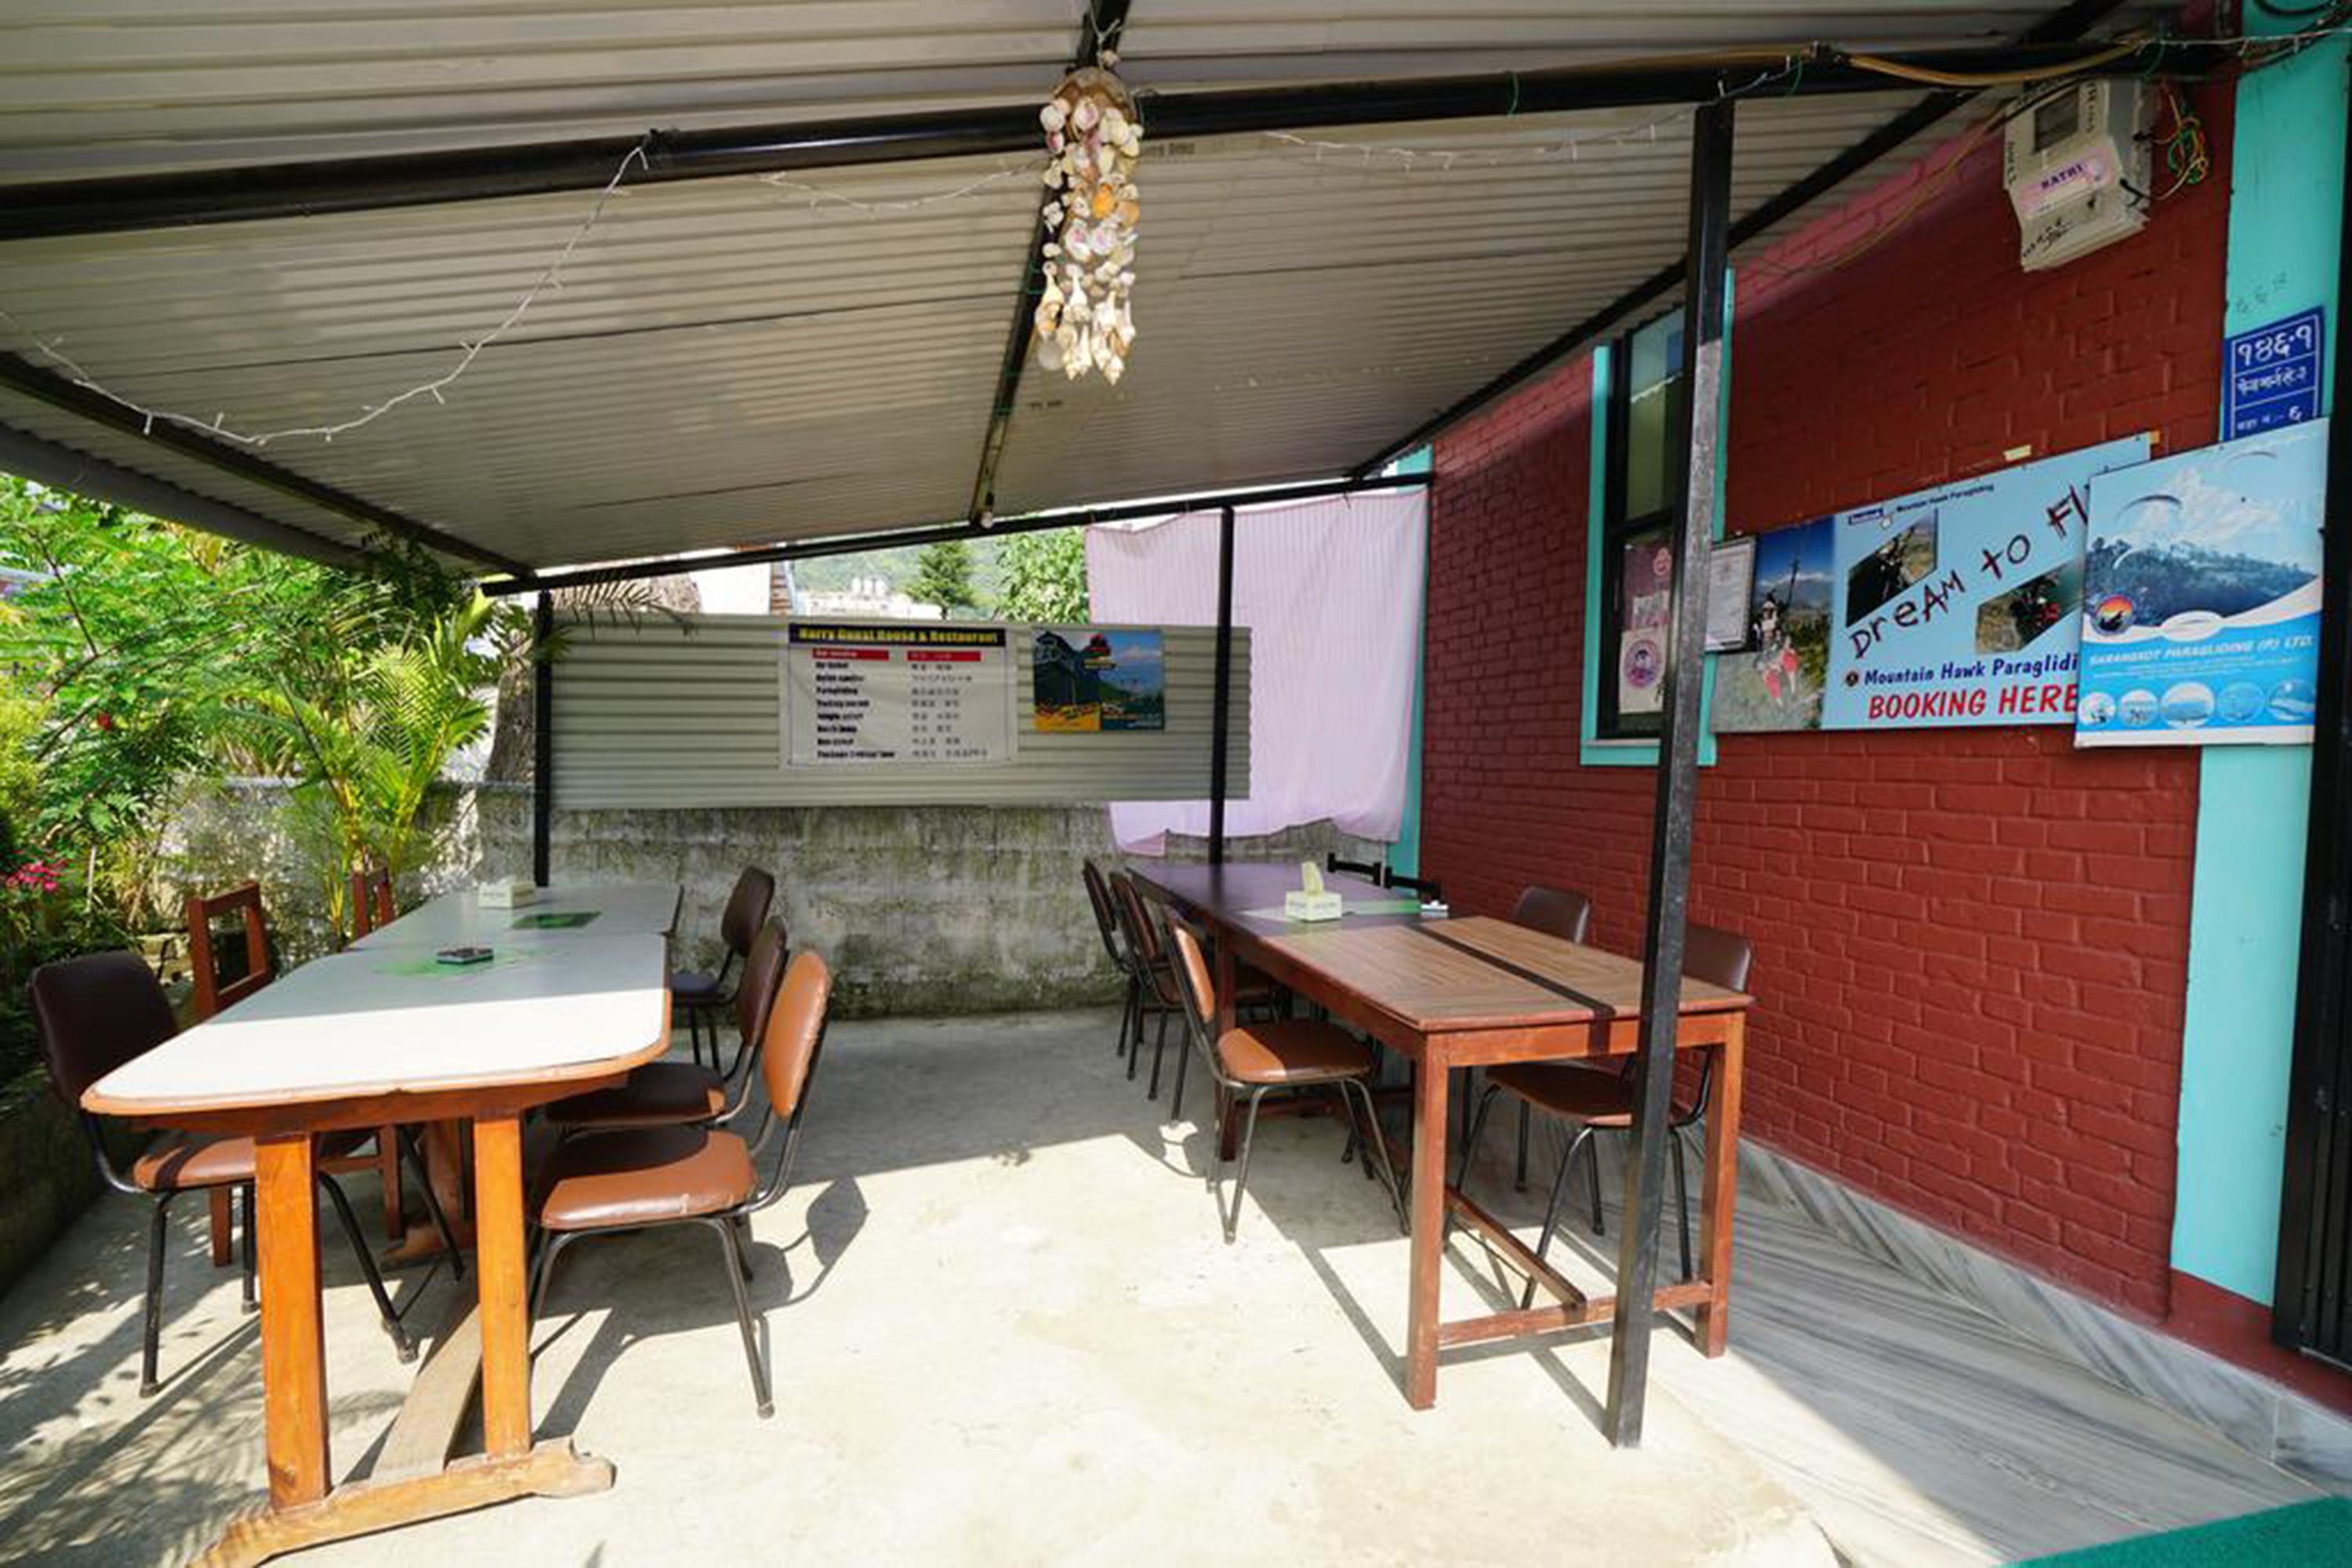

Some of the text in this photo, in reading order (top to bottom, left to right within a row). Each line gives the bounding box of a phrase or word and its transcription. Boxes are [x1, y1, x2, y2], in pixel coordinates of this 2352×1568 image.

[930, 630, 997, 644] Restaurant
[2165, 641, 2252, 659] PARAGLIDING
[1864, 667, 1934, 685] Mountain
[1941, 662, 1984, 680] Hawk
[1868, 684, 2078, 720] BOOKING HERE
